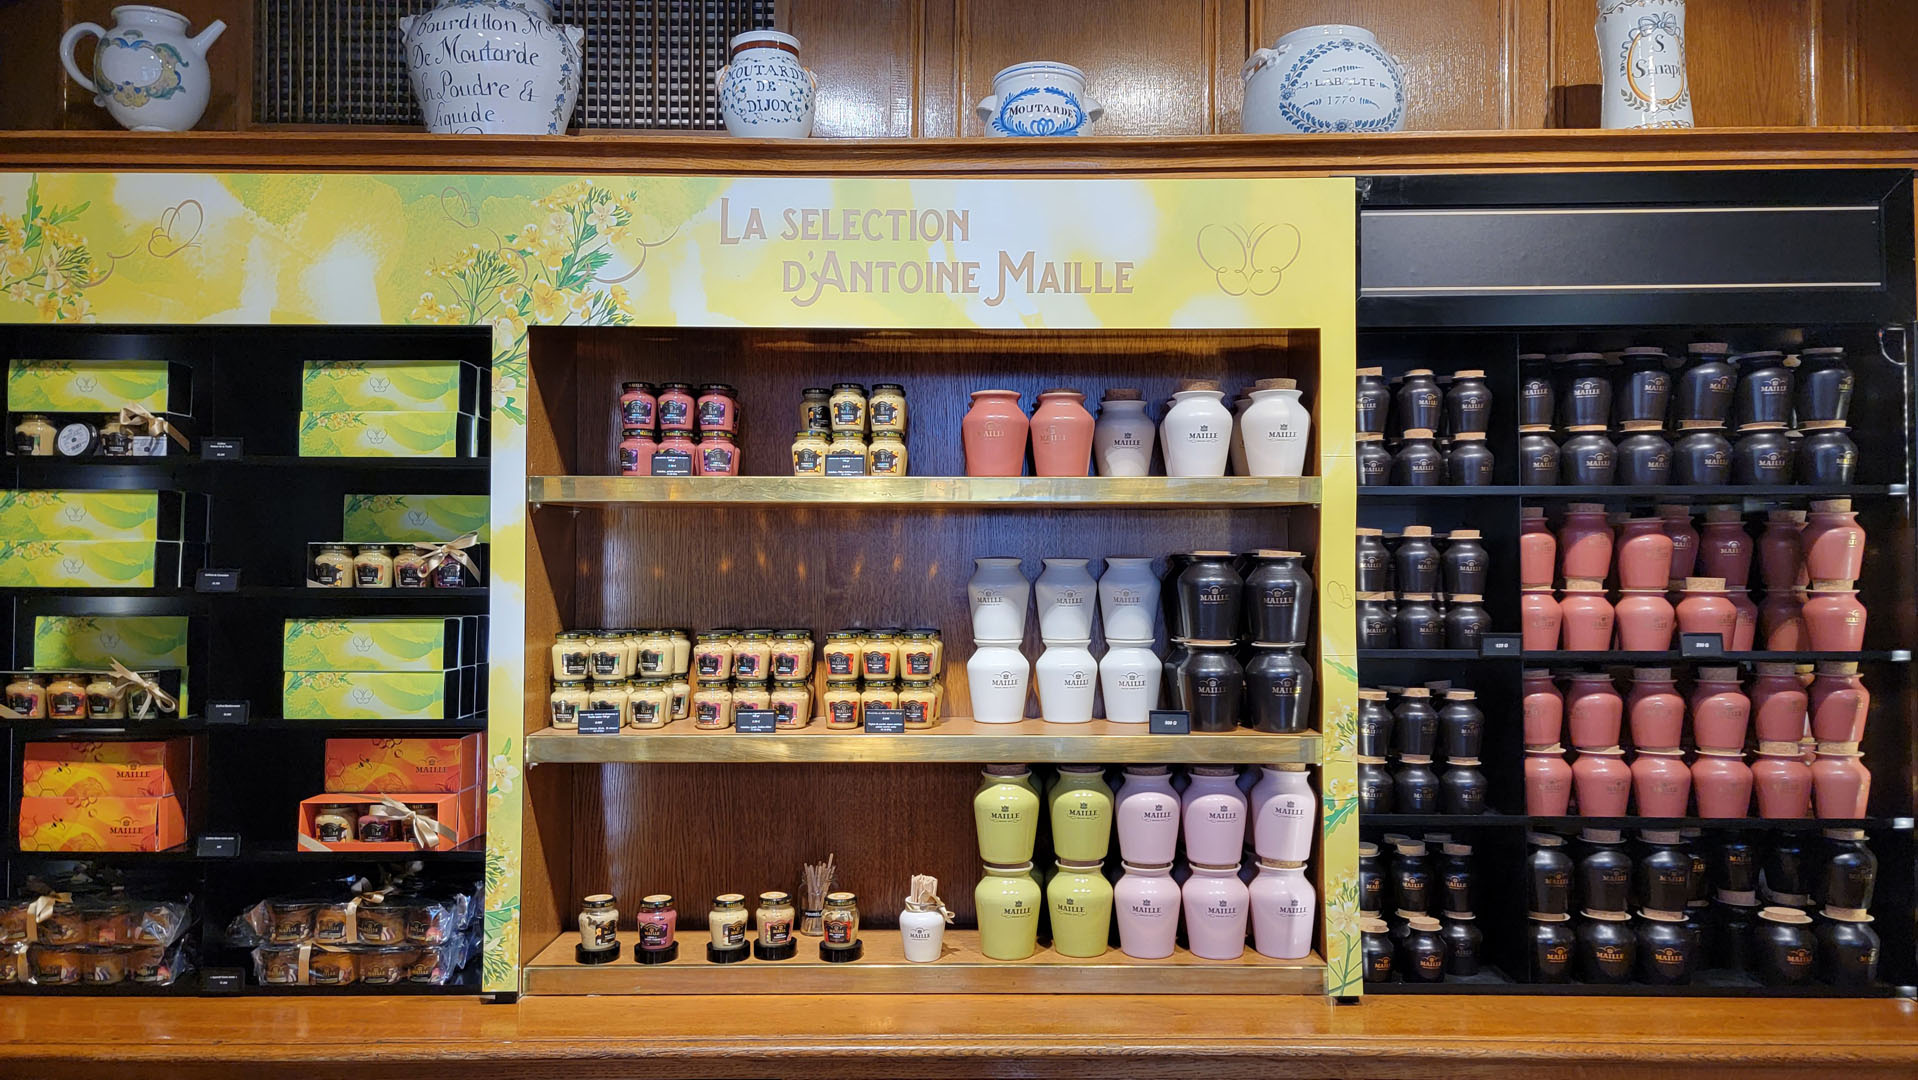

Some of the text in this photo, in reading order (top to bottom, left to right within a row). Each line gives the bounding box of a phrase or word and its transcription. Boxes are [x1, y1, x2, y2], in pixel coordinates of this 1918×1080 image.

[434, 34, 542, 66] Moutarde
[726, 64, 808, 84] MOUTARDE
[436, 70, 510, 102] Poudre
[756, 80, 777, 92] DE
[1326, 95, 1356, 106] 1770
[1008, 103, 1074, 119] MOUTARDE
[720, 198, 970, 246] LA SELECTION
[782, 250, 1134, 308] D'ANTOINE MAILLE
[1574, 388, 1601, 396] MAILLE
[1188, 432, 1218, 440] MAILLE
[976, 596, 1003, 604] MAILLE
[1056, 596, 1084, 604] MAILLE
[1112, 596, 1141, 604] MAILLE
[992, 678, 1018, 686] MAILLE
[1118, 680, 1146, 688] MAILLE
[116, 770, 151, 778] MAILLE
[415, 766, 448, 774] MAILLE
[1143, 810, 1172, 819] MAILLE
[1274, 806, 1304, 816] MAILLE
[990, 812, 1020, 820] MAILLE
[1208, 812, 1237, 820] MAILLE
[109, 826, 144, 835] MAILLE
[1004, 907, 1032, 915] MAILLE
[1057, 904, 1086, 913] MAILLE
[1132, 906, 1162, 914] MAILLE
[1208, 906, 1237, 914] MAILLE
[1279, 906, 1308, 914] MAILLE
